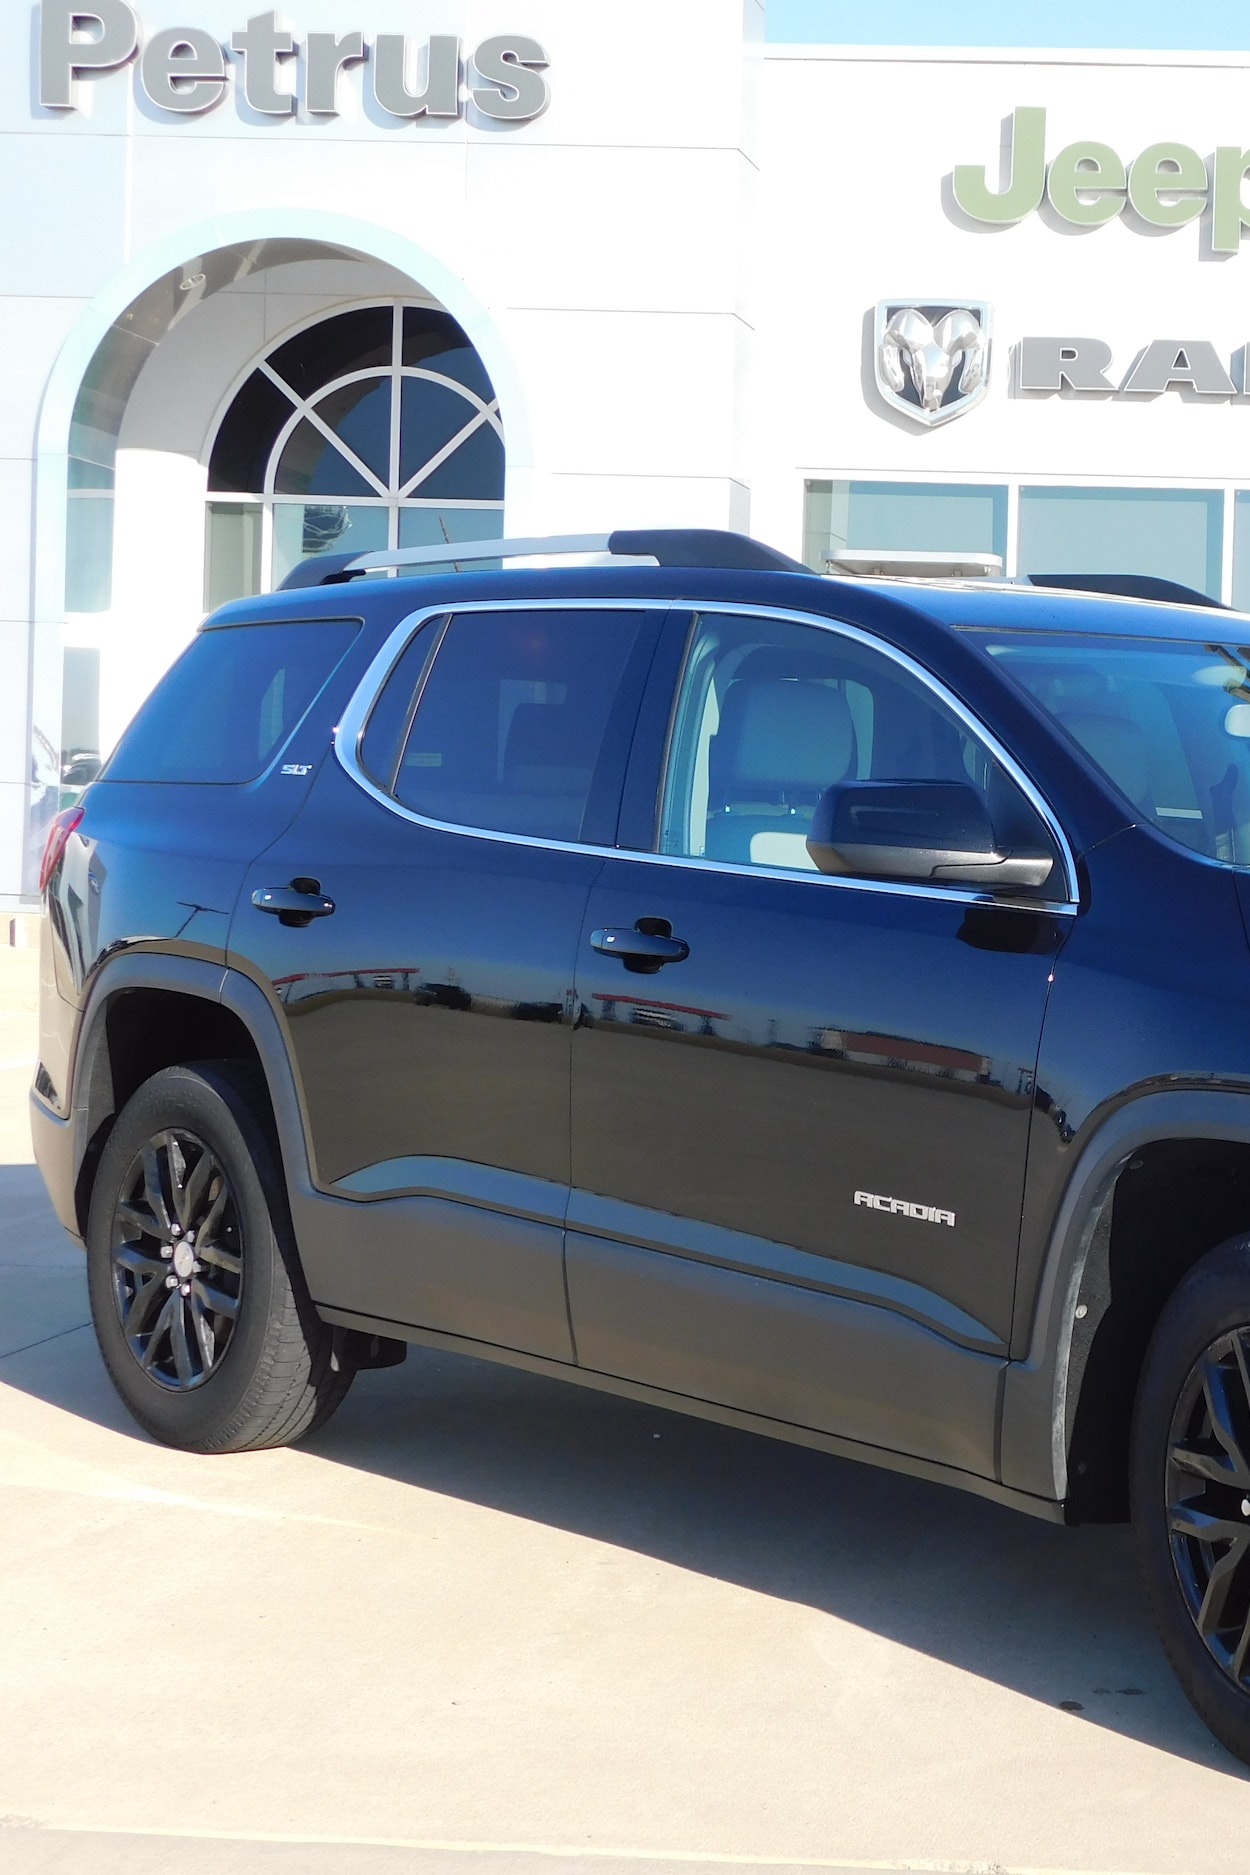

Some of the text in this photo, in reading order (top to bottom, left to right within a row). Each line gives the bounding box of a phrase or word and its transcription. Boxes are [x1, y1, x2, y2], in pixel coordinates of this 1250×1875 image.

[38, 0, 552, 120] Petrus
[280, 763, 313, 776] SLT
[853, 1190, 956, 1227] ACADIA
